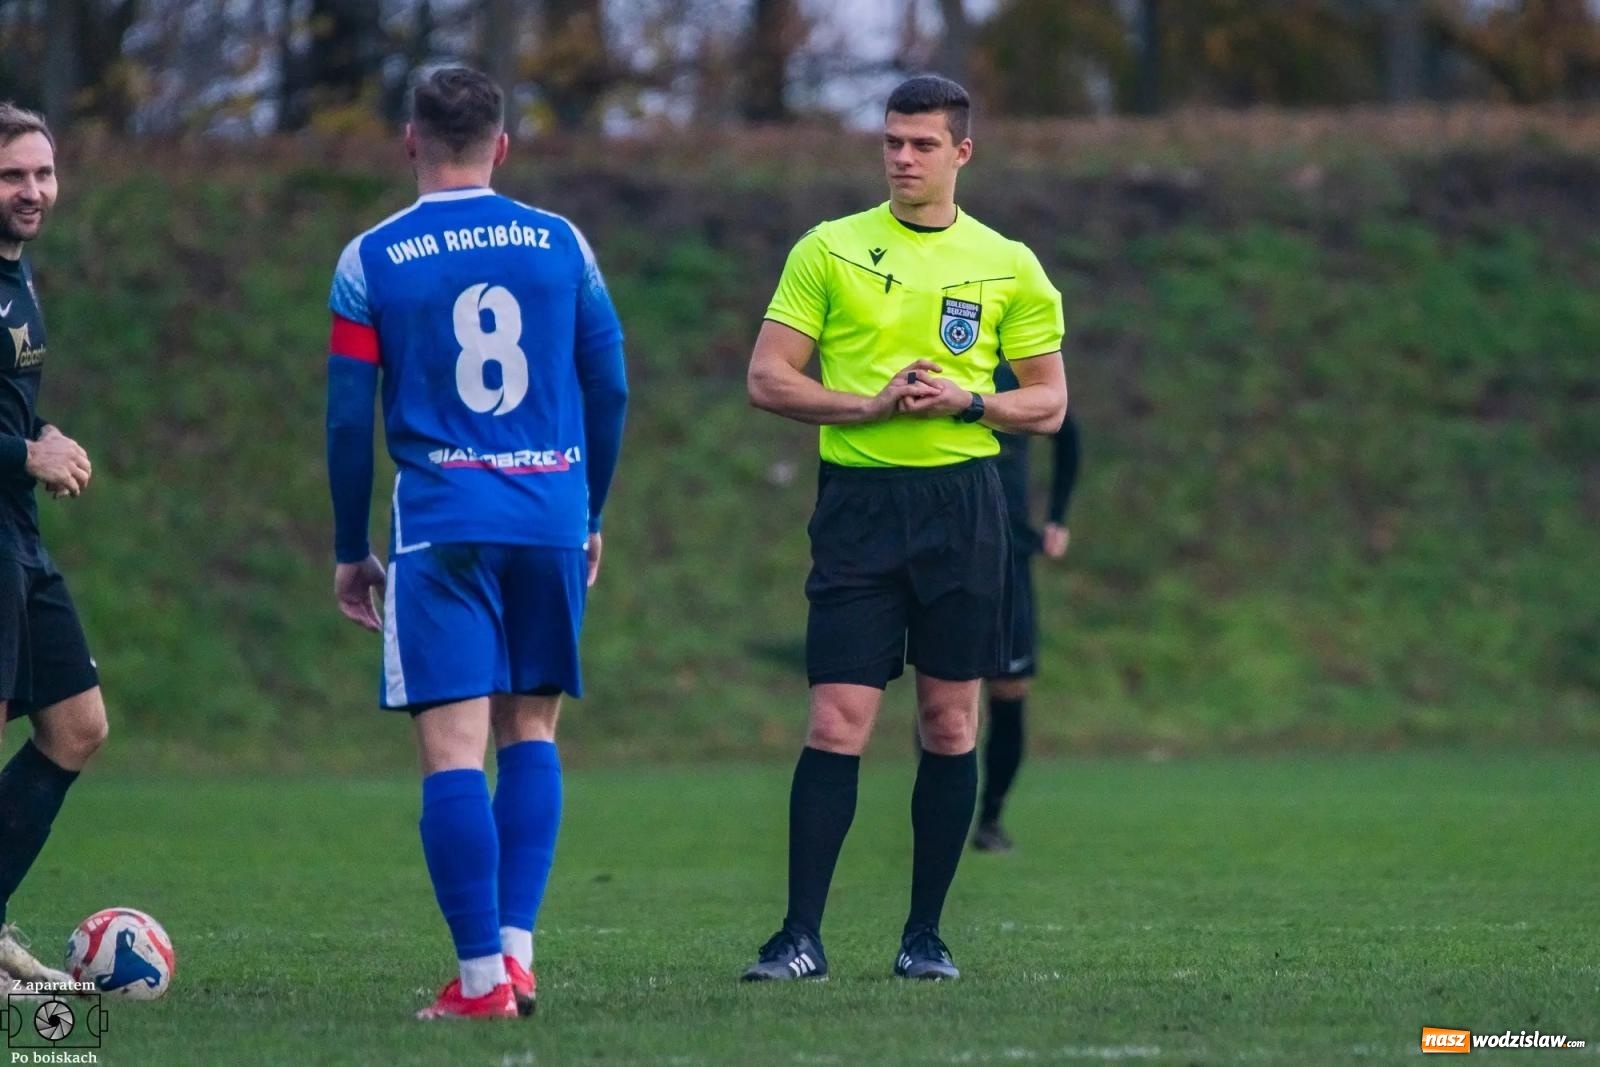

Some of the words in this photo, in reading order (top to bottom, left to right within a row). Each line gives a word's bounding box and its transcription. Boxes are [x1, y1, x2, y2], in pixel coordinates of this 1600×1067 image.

[386, 234, 439, 264] UNIA
[444, 221, 550, 251] RACIBÓRZ
[453, 282, 528, 416] 8
